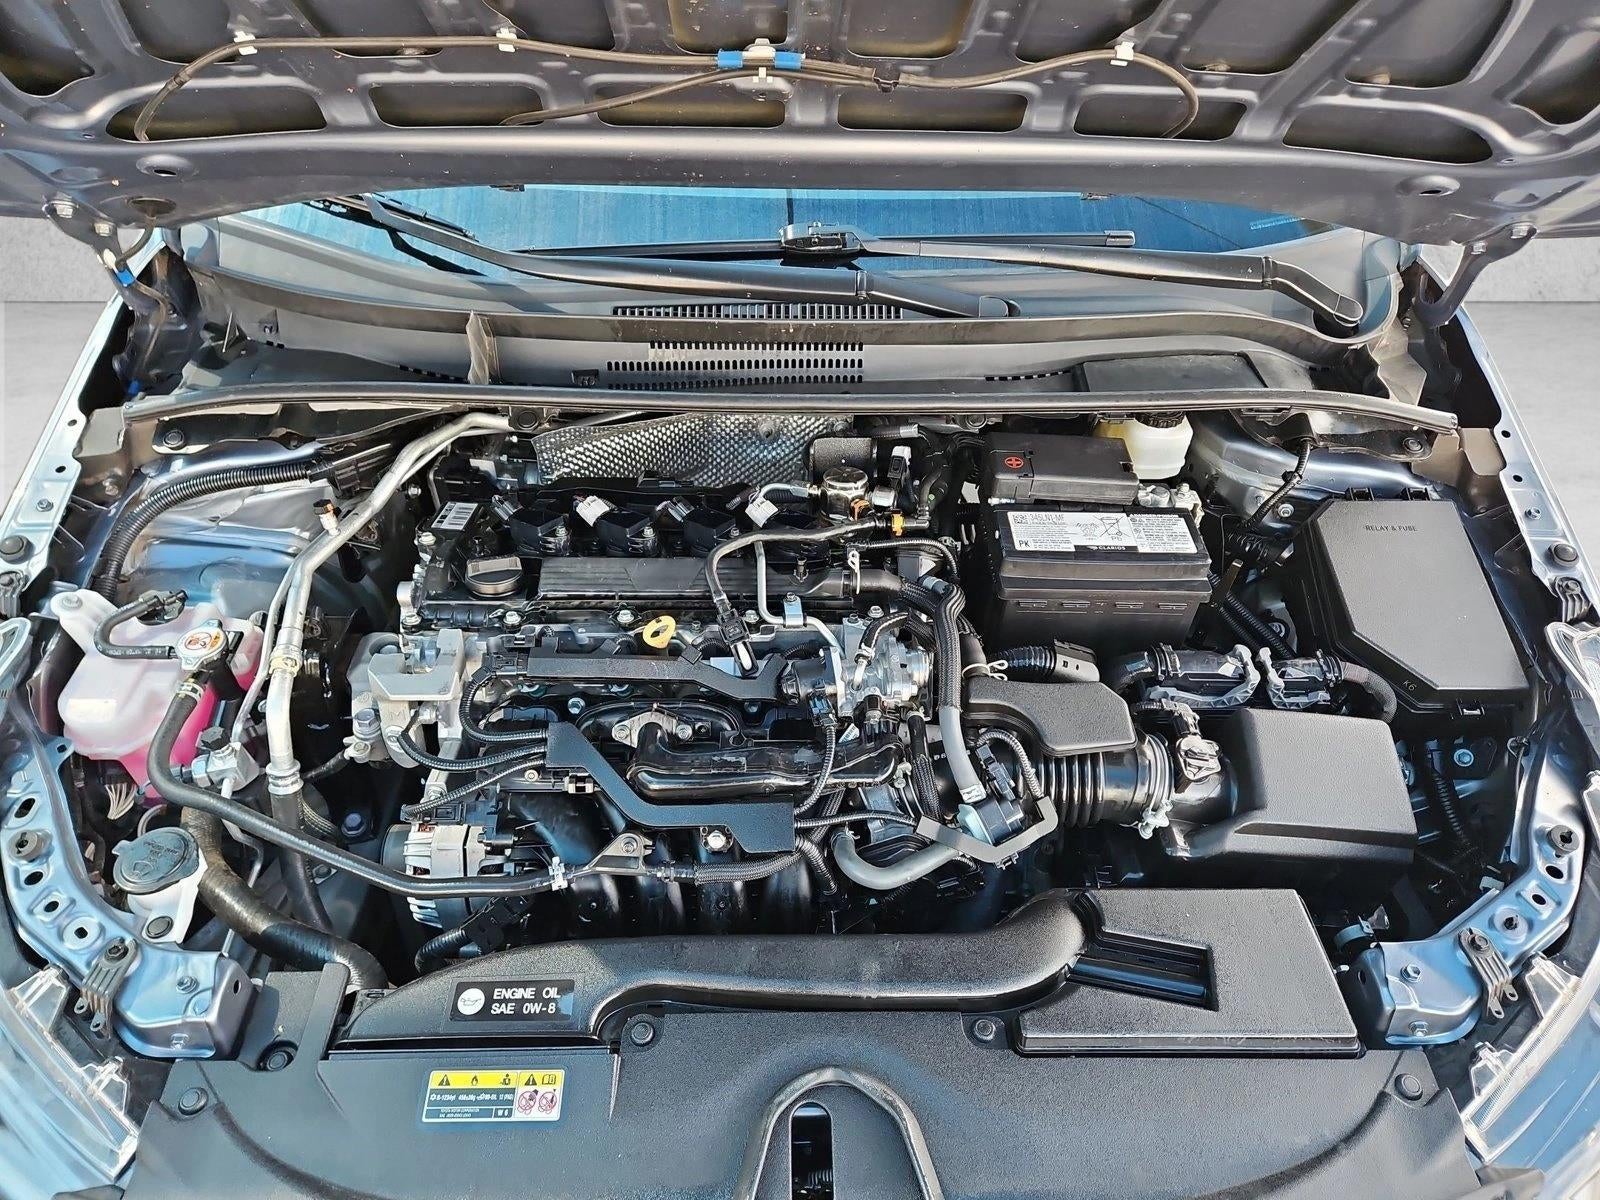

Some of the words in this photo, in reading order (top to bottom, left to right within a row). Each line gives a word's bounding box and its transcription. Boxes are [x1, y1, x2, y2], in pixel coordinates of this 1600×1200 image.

[1018, 539, 1031, 548] PK
[493, 988, 536, 1000] ENGINE
[542, 988, 562, 999] OIL
[490, 1003, 516, 1015] SAE
[522, 1003, 557, 1014] 0W-8
